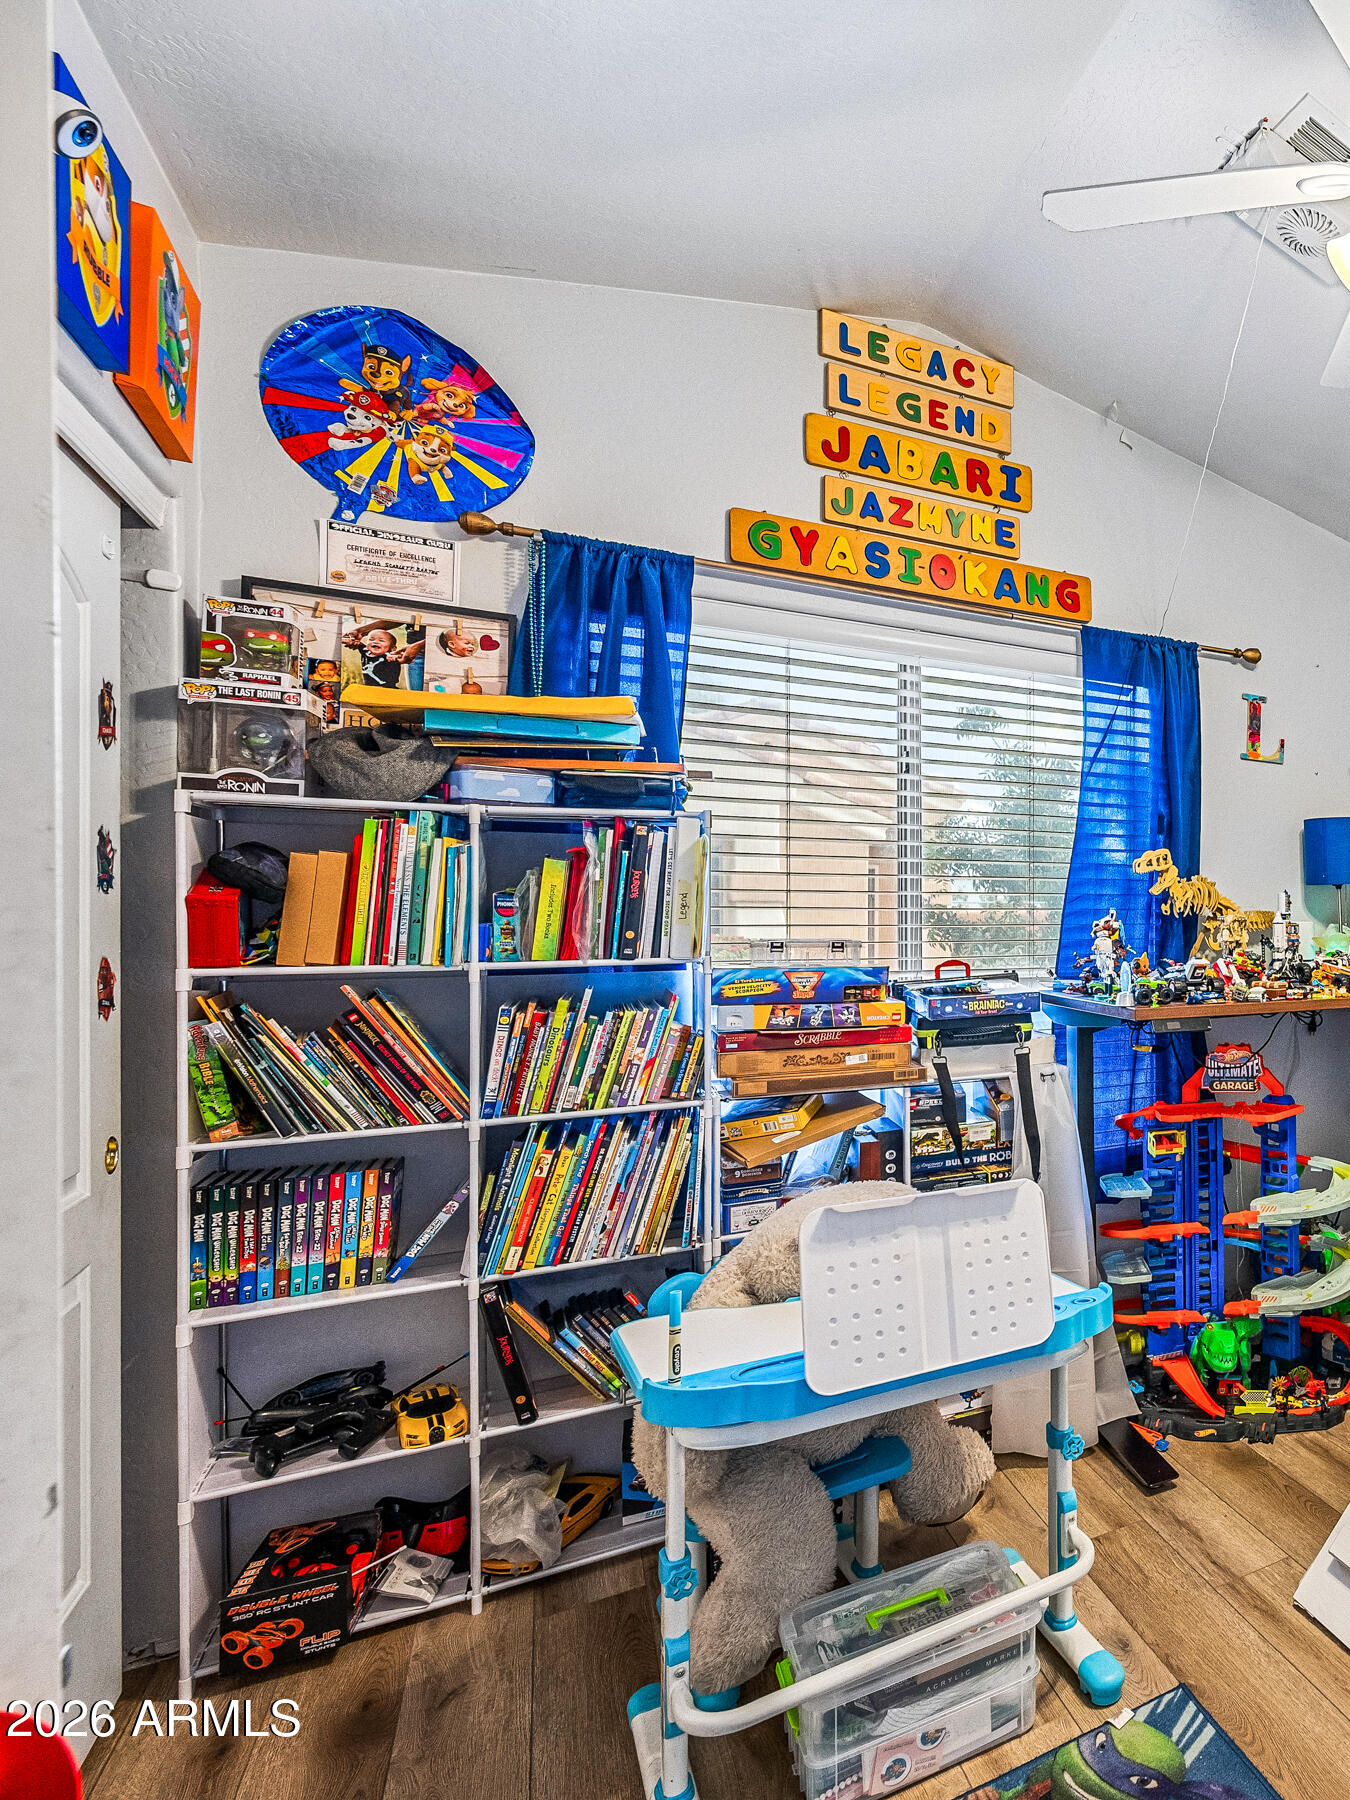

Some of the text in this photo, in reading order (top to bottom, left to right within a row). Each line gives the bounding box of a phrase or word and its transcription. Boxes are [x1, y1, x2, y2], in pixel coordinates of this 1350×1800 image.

[839, 322, 1001, 394] LEGACY
[839, 373, 1002, 443] LEGEND
[822, 426, 1022, 503] JABARI
[830, 486, 1016, 549] JAZMYNE
[347, 544, 386, 556] CERTIFICATE
[243, 606, 268, 616] RONIN
[270, 608, 283, 617] 44
[243, 672, 277, 682] RAPHAEL
[218, 685, 234, 695] THE
[235, 687, 256, 697] LAST
[257, 690, 282, 700] RONIN
[284, 694, 299, 704] 45
[1240, 693, 1286, 765] L
[228, 780, 266, 793] RONIN
[399, 836, 415, 935] EYEWITNESS THE ELEMENTS
[543, 883, 556, 939] Includes Two Books
[678, 892, 689, 920] Legend
[1191, 966, 1205, 979] G
[968, 999, 1005, 1011] BRAINIAC
[531, 1021, 541, 1038] BABY
[794, 1031, 842, 1046] SCRABBLE
[190, 1025, 209, 1061] Adventure
[495, 1035, 505, 1057] DINOS
[543, 1027, 560, 1067] Dinosaurs
[198, 1062, 213, 1085] BIBLE
[1208, 1059, 1259, 1078] ULTIMATE
[1213, 1081, 1254, 1090] GARAGE
[582, 1139, 593, 1159] Search
[972, 1155, 988, 1163] THE
[493, 1146, 519, 1212] Moonlight Animals
[551, 1172, 564, 1189] Pete
[576, 1165, 584, 1177] Find
[381, 1195, 392, 1208] DOG
[545, 1192, 557, 1207] Cat
[565, 1182, 579, 1206] Things
[295, 1203, 307, 1231] DOG MAN
[314, 1201, 325, 1214] DOG
[330, 1199, 342, 1226] DOG MAN
[347, 1198, 358, 1225] DOG MAN
[364, 1196, 376, 1223] DOG MAN
[380, 1208, 390, 1221] MAN
[559, 1206, 571, 1223] That
[574, 1209, 584, 1225] SOLAR
[212, 1212, 223, 1227] DOG
[227, 1210, 239, 1225] DOG
[243, 1209, 255, 1237] DOG MAN
[261, 1207, 272, 1234] DOG MAN
[280, 1205, 292, 1233] DOG MAN
[314, 1214, 323, 1228] MAN
[193, 1214, 205, 1242] DOG MAN
[211, 1226, 222, 1240] MAN
[227, 1225, 238, 1239] MAN
[568, 1225, 579, 1243] SYSTEM
[405, 1230, 431, 1258] DOG MAN
[227, 1582, 340, 1616] DOUBLE WHEEL
[256, 1592, 335, 1616] RC STUNT CAR
[300, 1629, 342, 1647] FLIP
[304, 1643, 336, 1655] STUNTS
[925, 1668, 972, 1693] ACRYLIC
